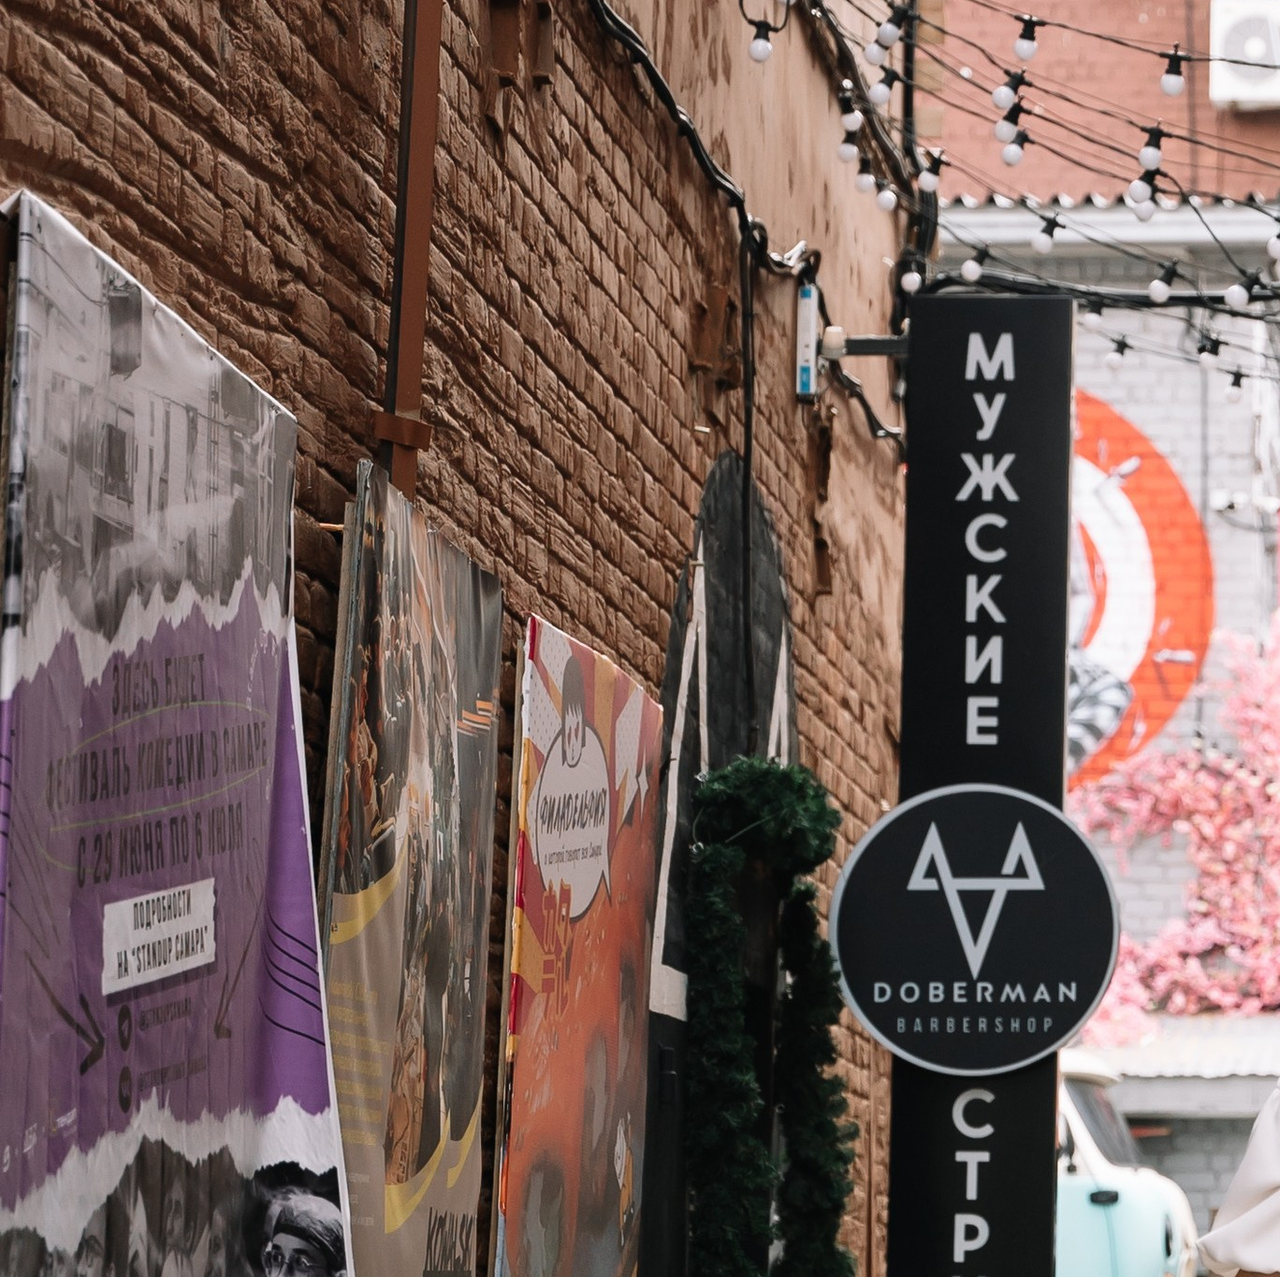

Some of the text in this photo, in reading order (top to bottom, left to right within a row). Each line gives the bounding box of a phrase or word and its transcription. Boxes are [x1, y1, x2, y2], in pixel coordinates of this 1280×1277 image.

[955, 332, 1020, 745] МУЖСКИЕ
[112, 663, 159, 719] ЗДЕСЬ
[164, 653, 205, 710] БУДЕТ
[46, 721, 267, 810] ФЕСТИВАЛЬ КОМЕДИИ В САМАРЕ
[77, 801, 243, 888] С 29 ИЮНЯ ПО 6 ИЮЛЯ
[133, 888, 192, 931] ПОДРОБНОСТИ
[117, 949, 130, 980] НА
[873, 981, 1077, 1003] DOBERMAN
[897, 1017, 1053, 1033] BARBERSHOP
